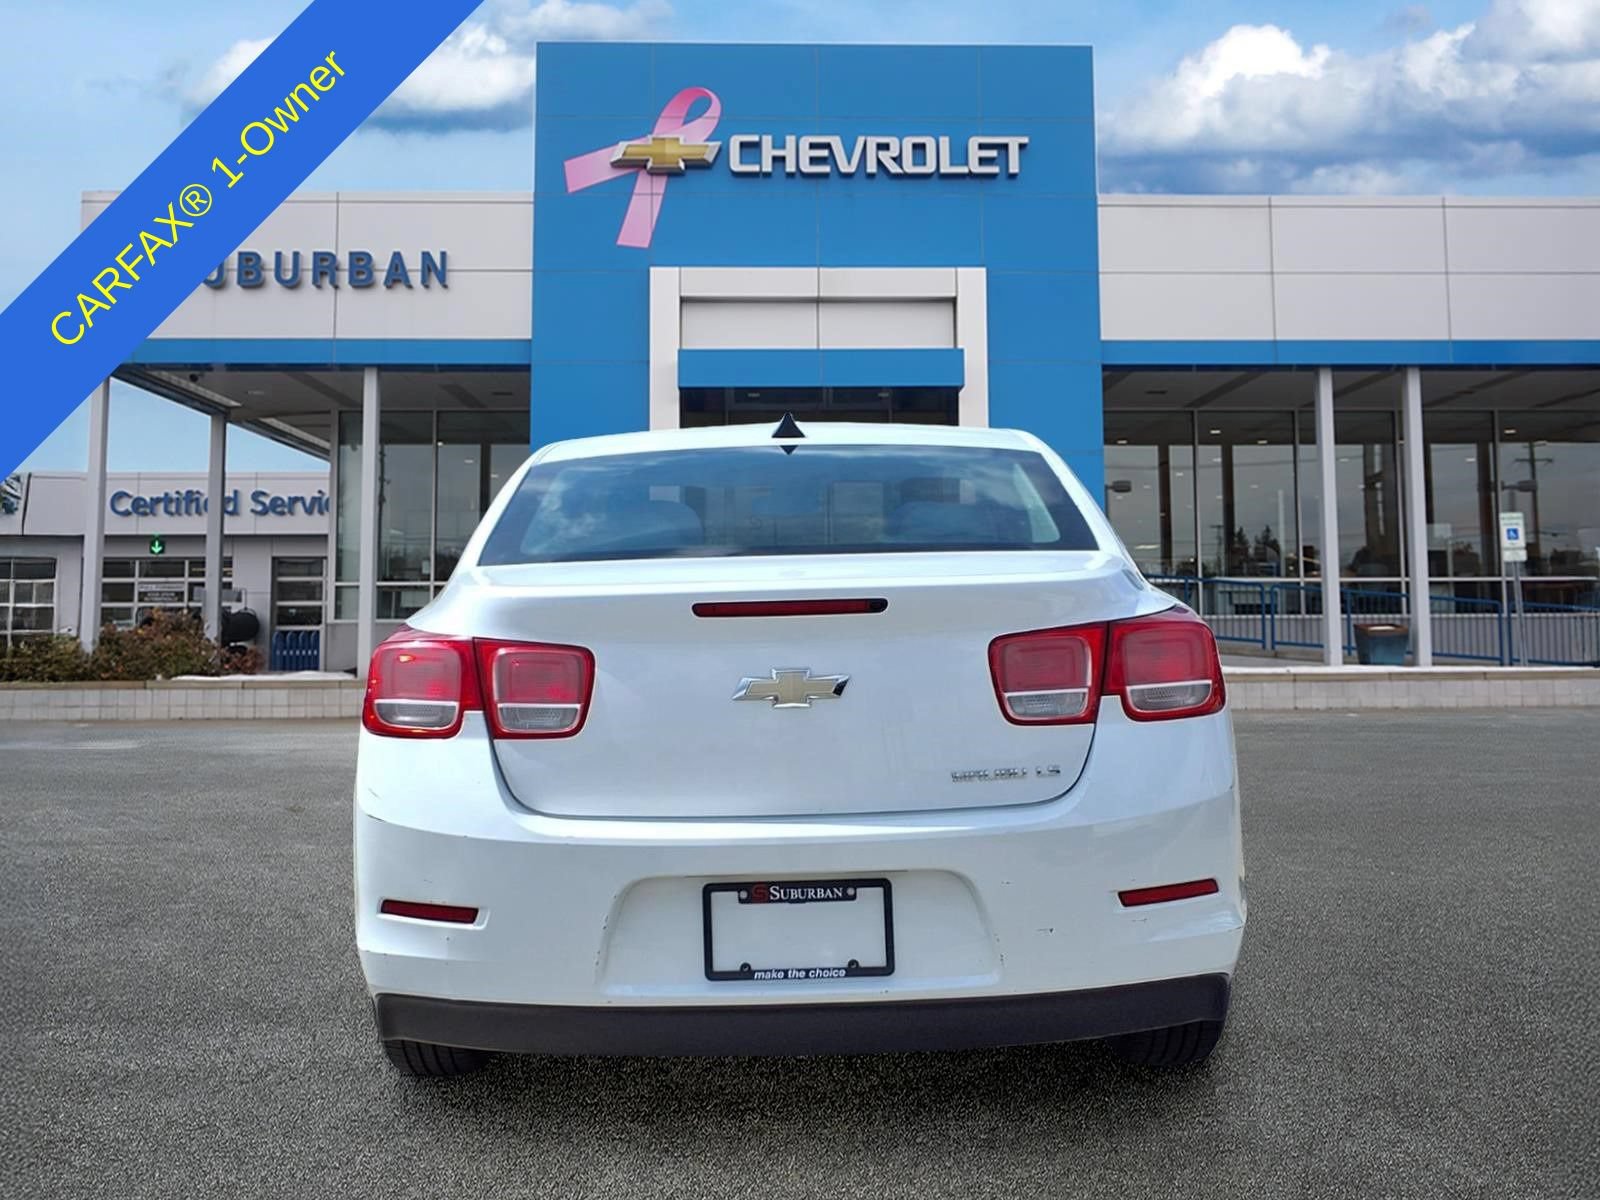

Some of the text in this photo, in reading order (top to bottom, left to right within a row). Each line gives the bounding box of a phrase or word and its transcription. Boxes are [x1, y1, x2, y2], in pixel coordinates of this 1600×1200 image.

[729, 134, 1029, 175] CHEVROLET
[203, 250, 448, 289] UBURBAN
[250, 490, 330, 517] Servi
[769, 885, 843, 901] SUBURBAN
[754, 967, 847, 980] make the choice
